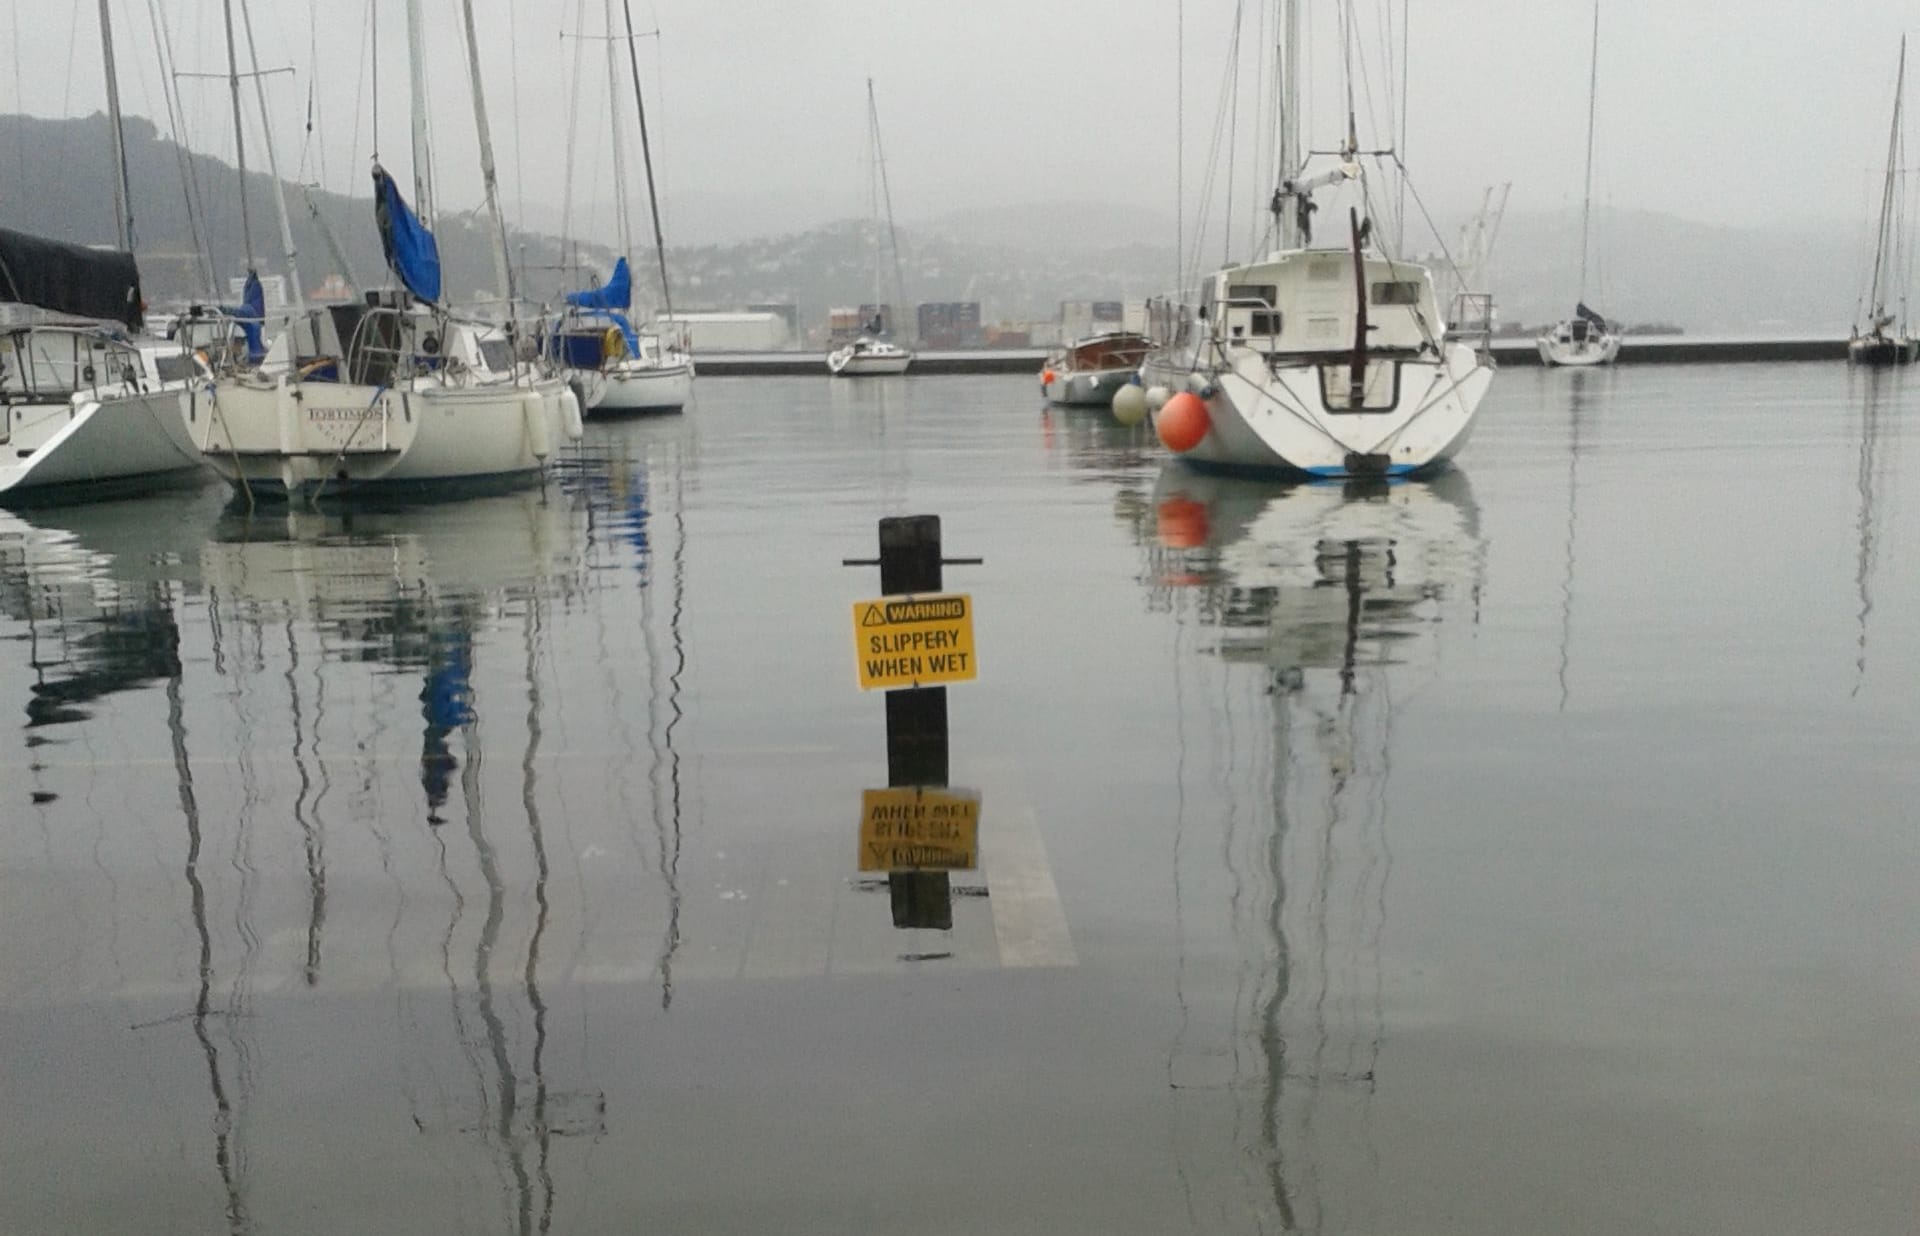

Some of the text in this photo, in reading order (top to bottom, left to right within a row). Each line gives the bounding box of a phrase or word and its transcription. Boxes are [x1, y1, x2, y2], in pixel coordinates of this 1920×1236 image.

[890, 601, 962, 621] WARNING
[870, 629, 959, 654] SLIPPERY
[867, 653, 968, 678] WHEN WET
